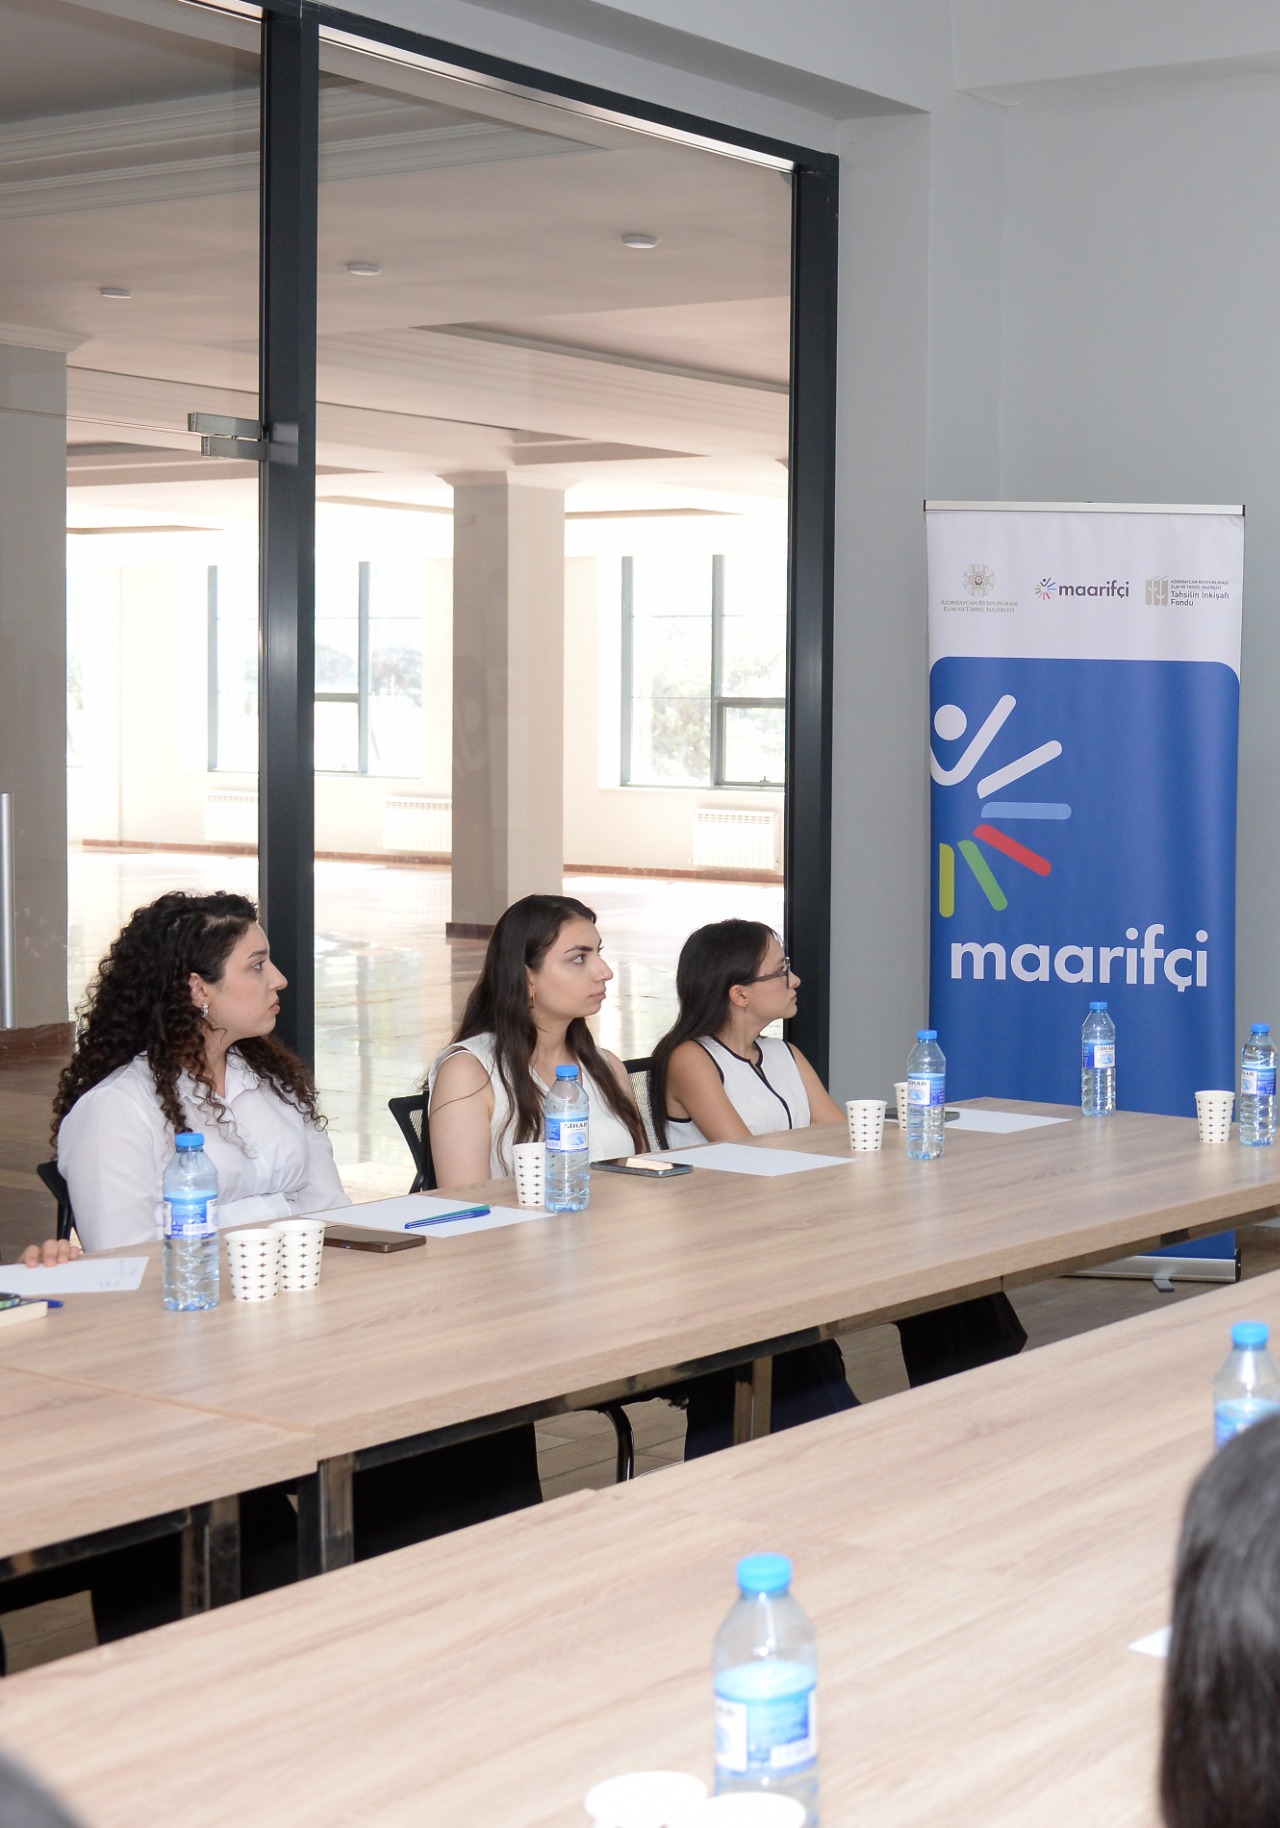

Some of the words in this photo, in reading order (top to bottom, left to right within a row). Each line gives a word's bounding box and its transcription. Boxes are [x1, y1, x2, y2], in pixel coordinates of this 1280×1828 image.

[1059, 580, 1130, 598] maarifçi
[1171, 591, 1200, 599] Təhsilin
[1171, 598, 1194, 606] Fondu
[951, 924, 1208, 992] maarifçi
